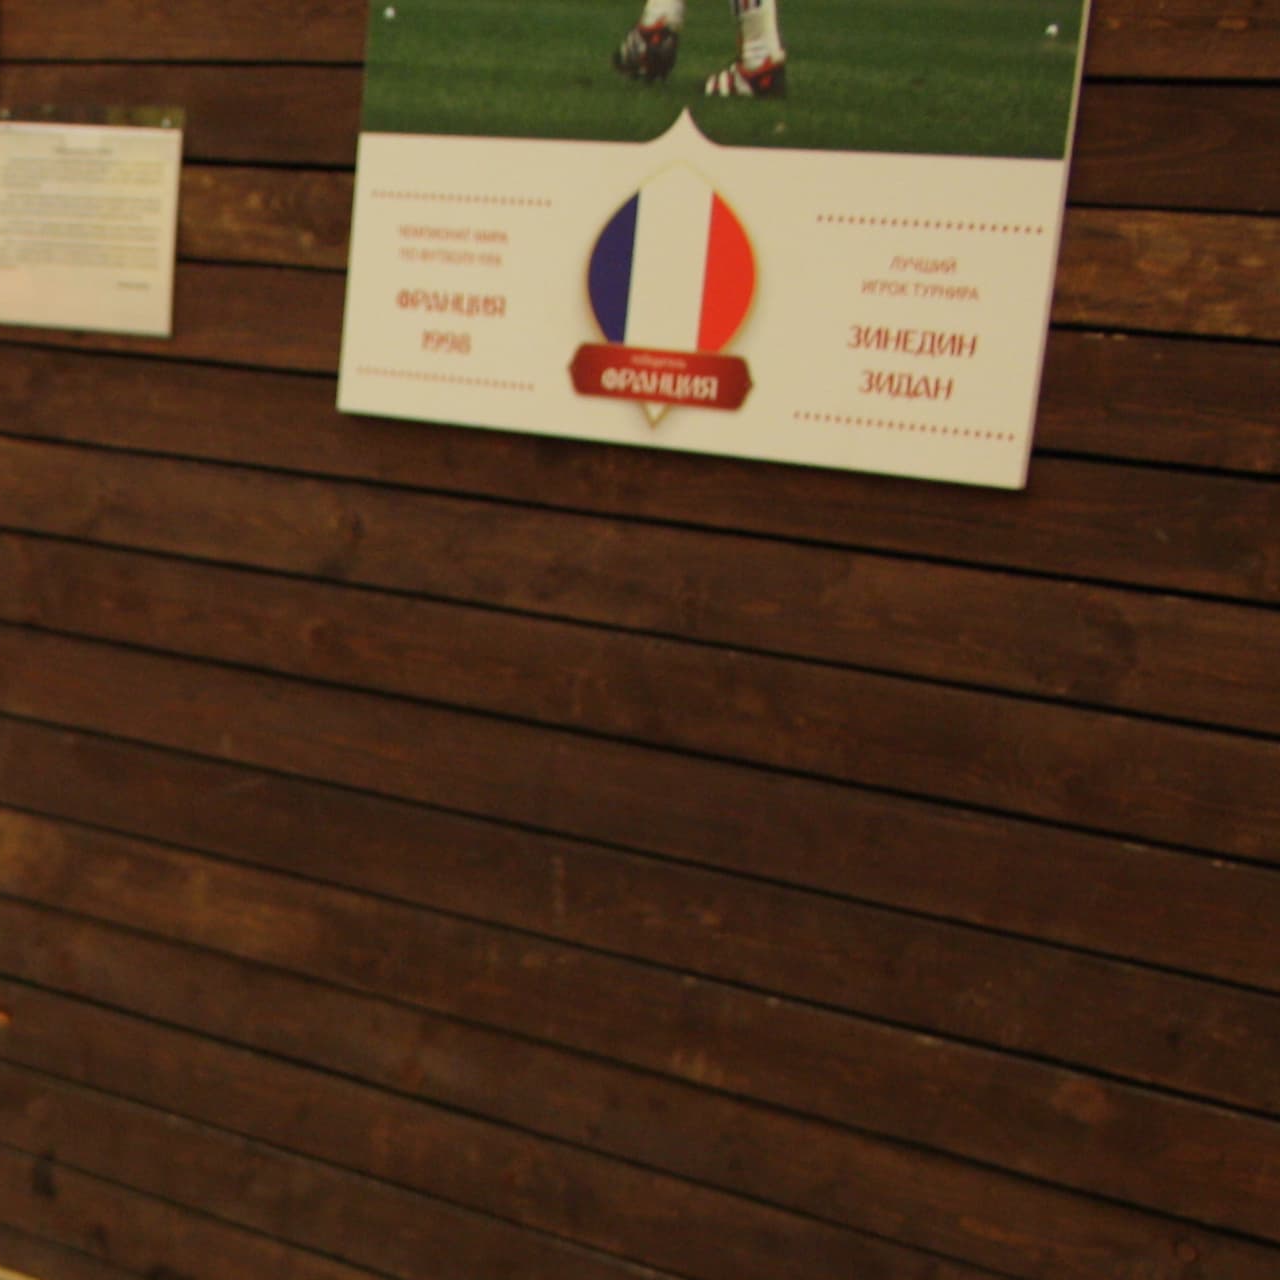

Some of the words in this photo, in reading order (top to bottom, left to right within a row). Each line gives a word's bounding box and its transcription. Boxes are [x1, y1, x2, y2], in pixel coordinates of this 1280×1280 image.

[890, 256, 958, 275] ЛУЧШИЙ
[861, 280, 907, 297] ИГРОК
[913, 283, 980, 302] ТУРНИРА
[846, 324, 979, 358] ЗИНЕДИН
[600, 367, 719, 401] ФРАНЦИЯ
[858, 369, 956, 400] ЗИДАН
